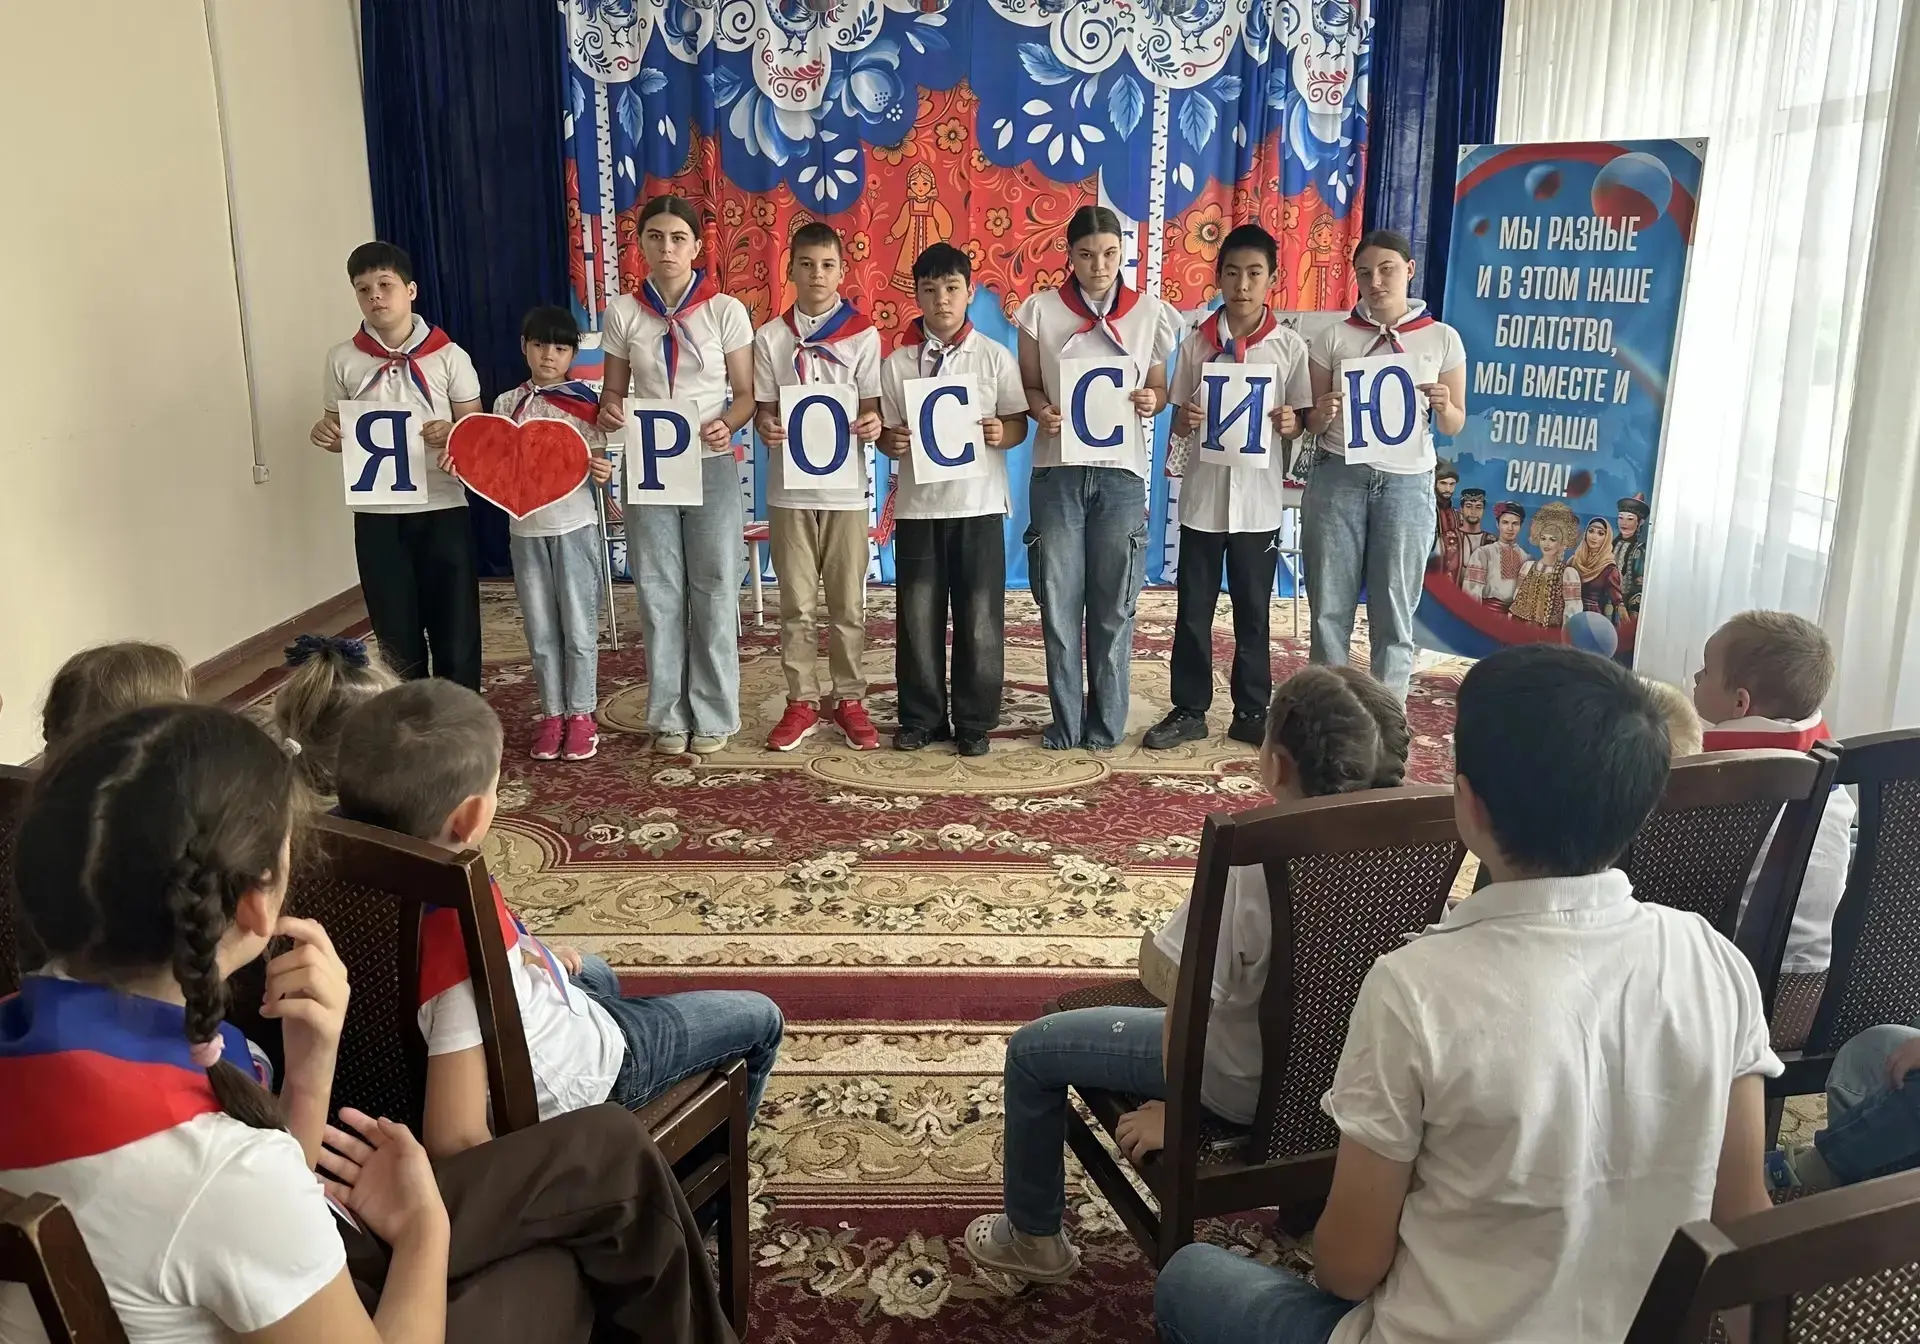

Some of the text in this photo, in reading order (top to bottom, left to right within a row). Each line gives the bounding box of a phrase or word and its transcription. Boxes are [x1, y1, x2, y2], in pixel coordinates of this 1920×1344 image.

[1499, 216, 1640, 251] МЫ РАЗНЫЕ
[1476, 266, 1653, 303] И В ЭТОМ НАШЕ
[1495, 315, 1618, 357] БОГАТСТВО,
[1474, 362, 1630, 404] МЫ ВМЕСТЕ И
[1491, 411, 1598, 451] ЭТО НАША
[1506, 460, 1570, 497] СИЛА!
